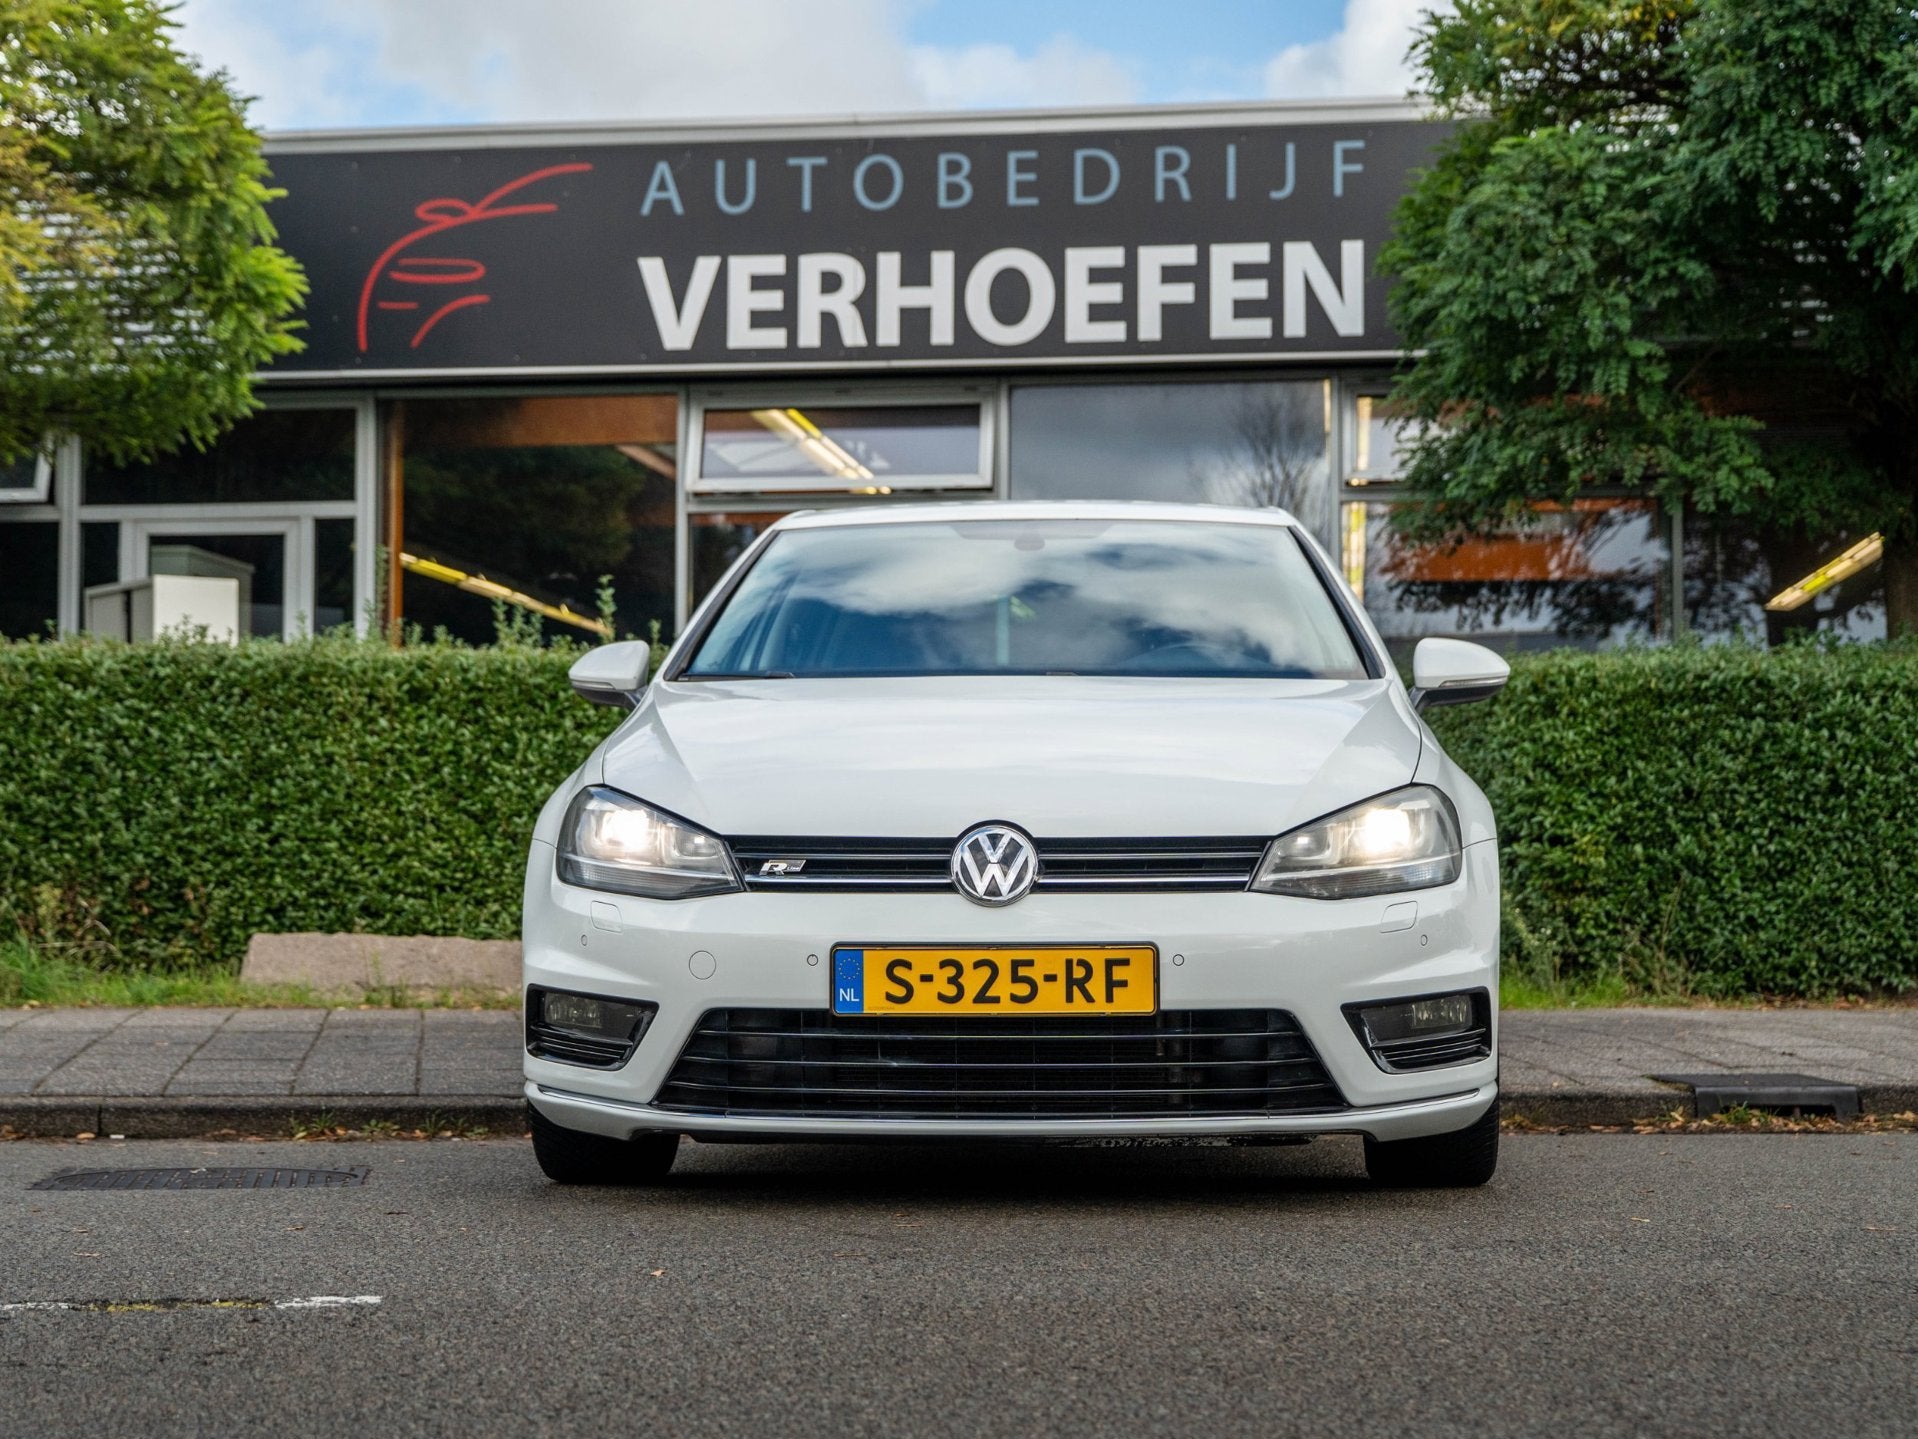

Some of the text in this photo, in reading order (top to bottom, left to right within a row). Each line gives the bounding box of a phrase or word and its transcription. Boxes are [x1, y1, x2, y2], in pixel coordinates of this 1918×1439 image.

[640, 139, 1366, 217] AUTOBEDRIJF
[637, 239, 1365, 351] VERHOEFEN
[957, 827, 1033, 901] VW
[839, 988, 860, 1002] NL
[885, 958, 1131, 1005] S-325-RF
